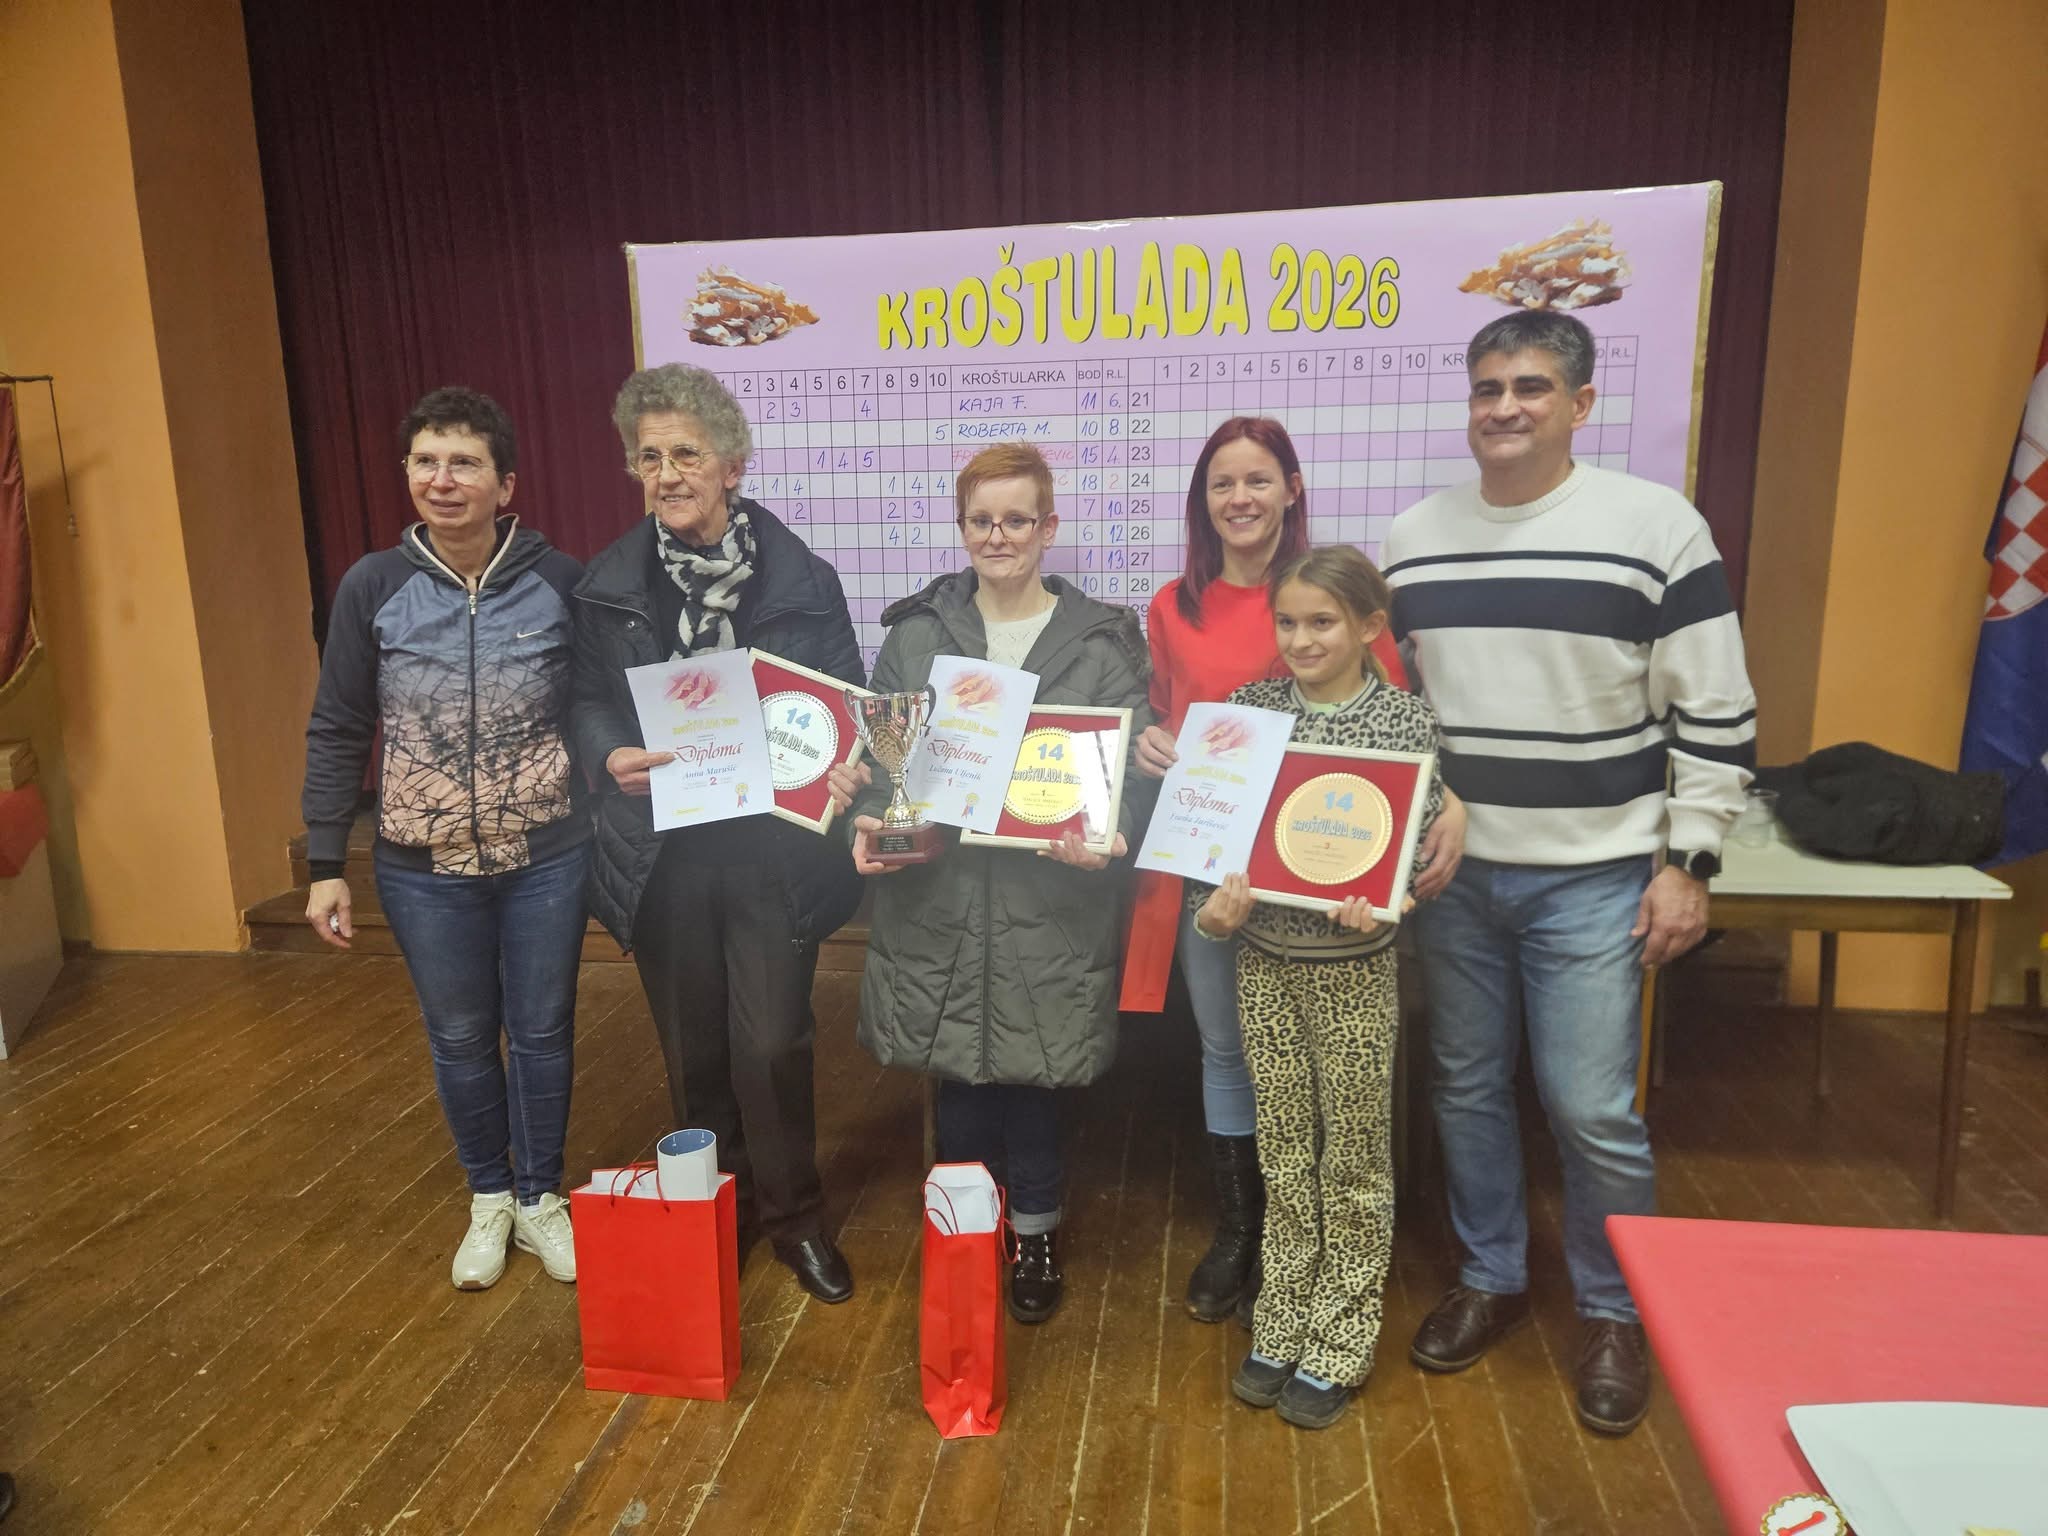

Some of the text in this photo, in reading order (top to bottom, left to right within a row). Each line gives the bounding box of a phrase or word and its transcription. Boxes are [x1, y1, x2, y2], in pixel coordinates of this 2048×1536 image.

[877, 241, 1401, 349] KROŠTULADA 2026
[1163, 364, 1169, 378] 1
[1190, 362, 1200, 377] 2
[1216, 361, 1226, 376] 3
[1243, 360, 1253, 375] 4
[1270, 359, 1280, 374] 5
[1298, 358, 1308, 373] 6
[1325, 356, 1335, 372] 7
[1353, 355, 1363, 371] 8
[1381, 354, 1392, 369] 9
[1405, 353, 1426, 369] 10
[743, 378, 752, 392] 2
[766, 378, 775, 392] 3
[789, 377, 799, 391] 4
[813, 376, 823, 390] 5
[837, 376, 846, 389] 6
[861, 374, 870, 389] 7
[885, 374, 895, 388] 8
[909, 373, 919, 387] 9
[929, 372, 947, 387] 10
[962, 369, 1066, 385] KROŠTULARKA
[1078, 369, 1101, 380] BOD
[1106, 369, 1126, 380] R.L.
[767, 402, 776, 418] 2
[790, 401, 800, 417] 3
[861, 400, 871, 417] 4
[959, 397, 1003, 412] KAJA
[1081, 392, 1097, 410] 11
[1131, 392, 1149, 407] 21
[935, 424, 949, 440] 5
[958, 422, 1027, 438] ROBERTA
[1034, 421, 1051, 435] M.
[1081, 421, 1098, 436] 10
[1131, 419, 1151, 433] 22
[817, 451, 825, 468] 1
[838, 452, 848, 469] 4
[863, 451, 874, 468] 5
[1081, 445, 1100, 465] 15
[1131, 446, 1151, 461] 23
[747, 480, 759, 495] 4
[771, 478, 779, 493] 1
[793, 478, 804, 495] 4
[888, 476, 896, 493] 1
[911, 476, 923, 494] 4
[936, 476, 946, 494] 4
[1081, 474, 1098, 491] 18
[1131, 473, 1150, 487] 24
[795, 503, 806, 519] 2
[887, 502, 900, 519] 2
[913, 501, 924, 519] 3
[1084, 498, 1096, 516] 7
[1131, 499, 1150, 514] 25
[889, 525, 899, 545] 4
[911, 527, 924, 544] 2
[1083, 525, 1094, 541] 6
[1131, 526, 1150, 540] 26
[939, 550, 946, 568] 1
[1086, 549, 1093, 568] 1
[1131, 552, 1149, 566] 27
[1082, 576, 1098, 593] 10
[1131, 578, 1150, 592] 28
[786, 707, 812, 730] 14
[766, 726, 803, 753] OŠTULADA
[674, 741, 744, 767] Diploma
[777, 753, 785, 761] 2
[927, 739, 992, 765] Diploma
[1037, 743, 1064, 761] 14
[710, 776, 718, 786] 2
[947, 777, 953, 787] 1
[1172, 787, 1240, 814] Diploma
[1324, 792, 1354, 812] 14
[1190, 827, 1198, 837] 3
